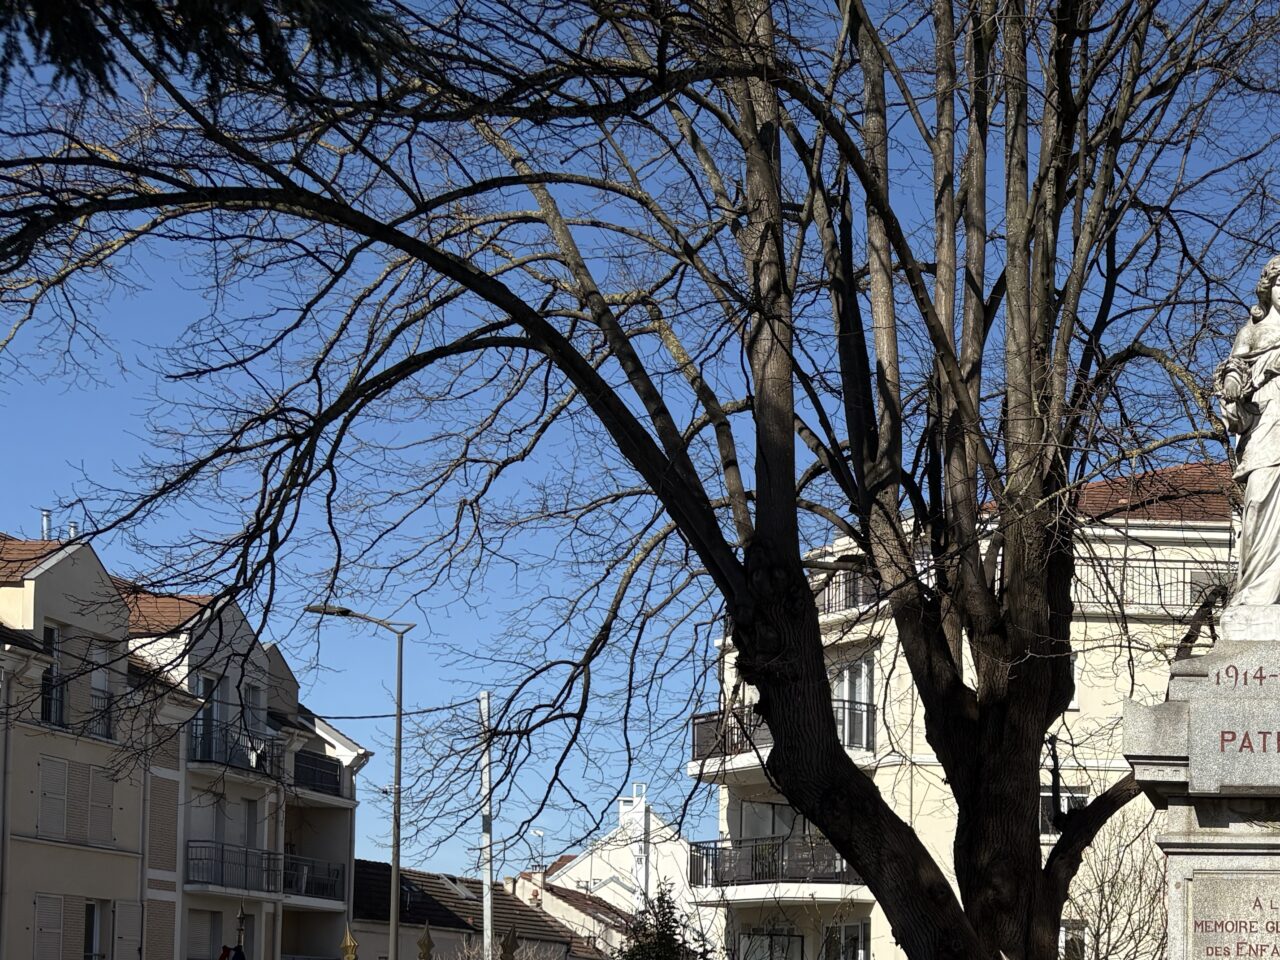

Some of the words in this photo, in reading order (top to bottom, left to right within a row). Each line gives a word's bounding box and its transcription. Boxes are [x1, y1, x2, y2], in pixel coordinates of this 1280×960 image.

[1252, 896, 1263, 911] A
[1193, 919, 1259, 934] MEMOIRE
[1206, 945, 1231, 957] DES
